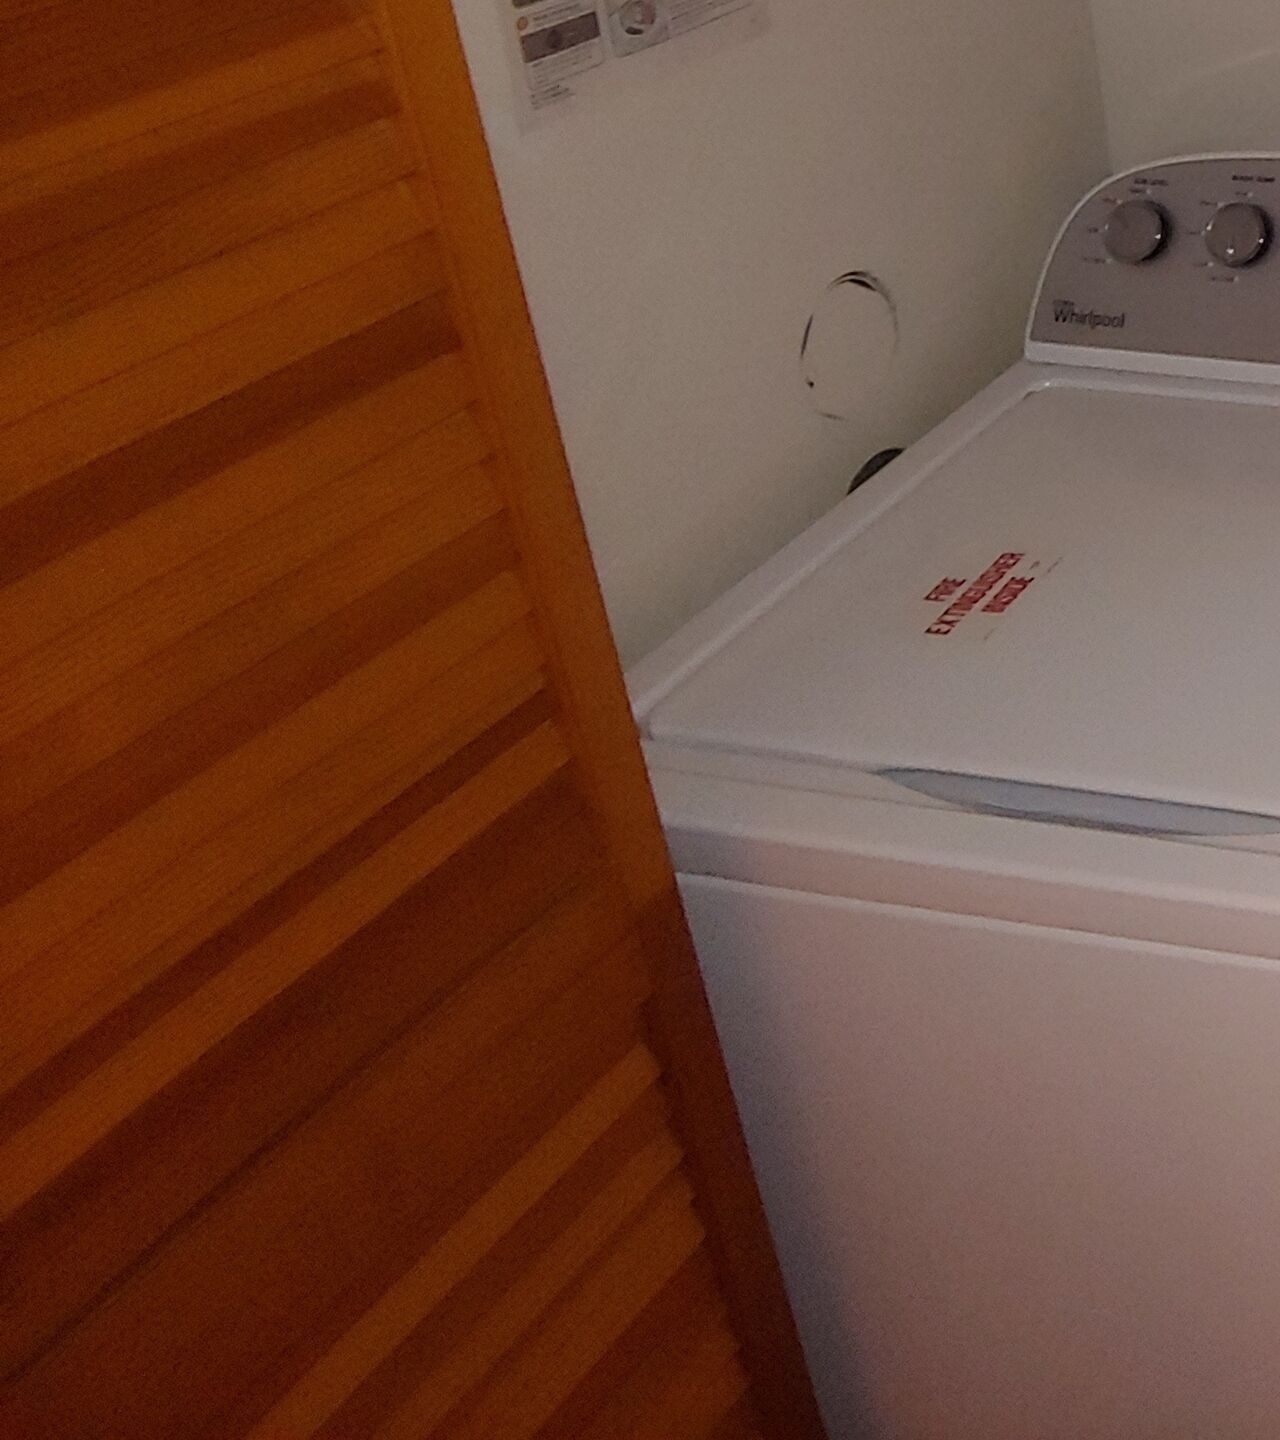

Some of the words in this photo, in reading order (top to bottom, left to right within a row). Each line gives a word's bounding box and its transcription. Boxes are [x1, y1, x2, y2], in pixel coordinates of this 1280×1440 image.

[1054, 309, 1126, 329] Whirlpool
[923, 577, 967, 602] FIRE
[924, 552, 1026, 635] EXTINGUISHER
